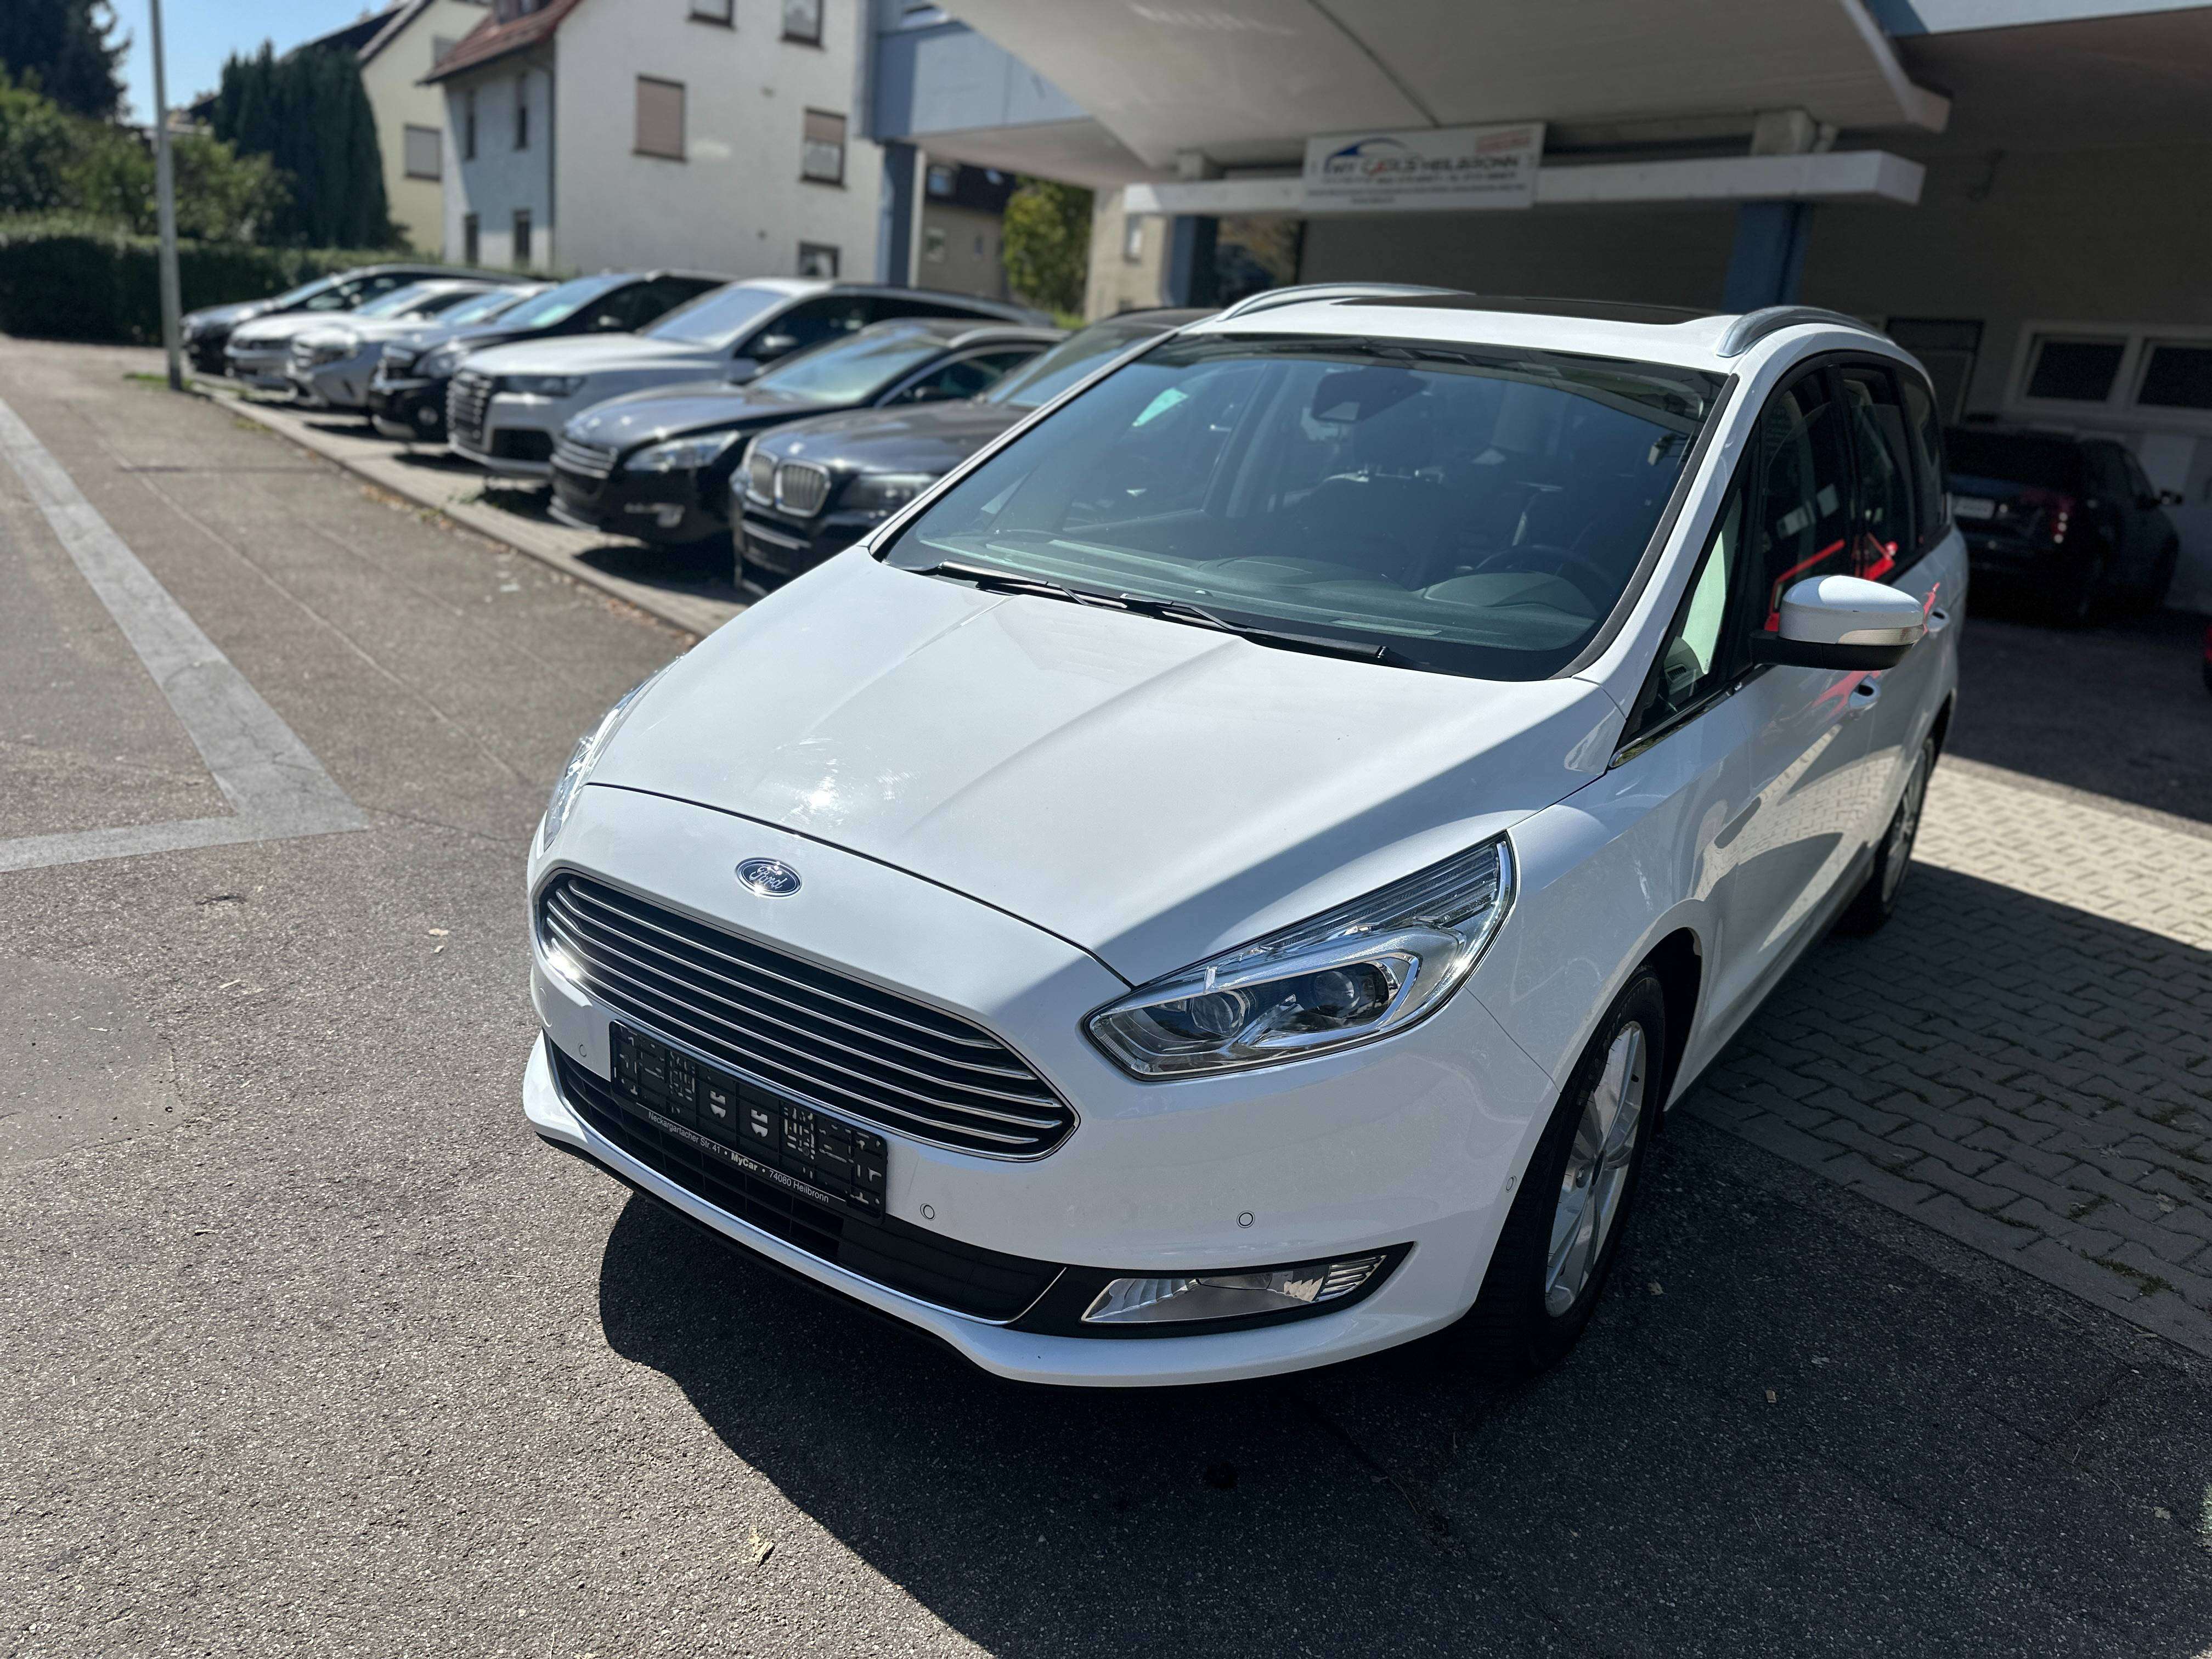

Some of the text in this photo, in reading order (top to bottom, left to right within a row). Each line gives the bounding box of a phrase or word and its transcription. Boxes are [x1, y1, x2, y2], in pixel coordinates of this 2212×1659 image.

[749, 866, 787, 889] Ford
[648, 1111, 830, 1203] Neckargartacher Str. 41 MyCar 74080 Heilbronn
